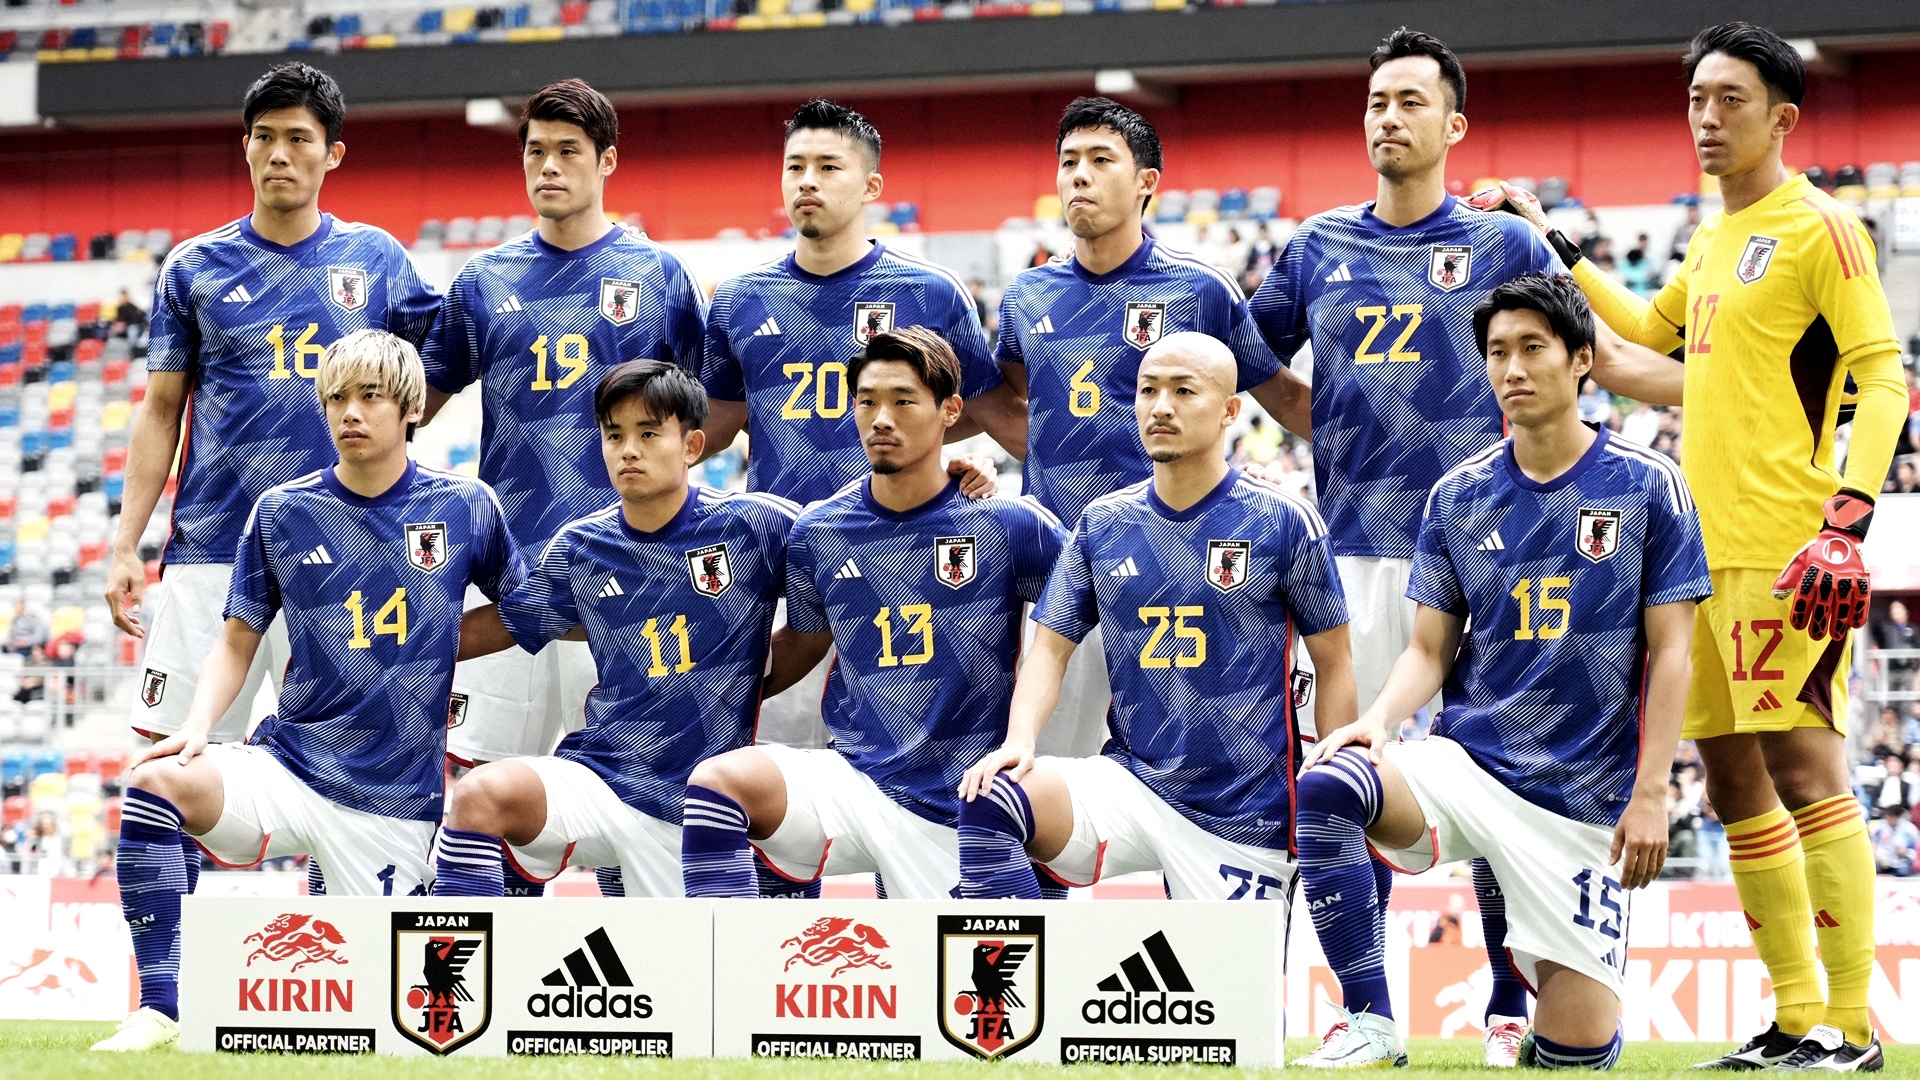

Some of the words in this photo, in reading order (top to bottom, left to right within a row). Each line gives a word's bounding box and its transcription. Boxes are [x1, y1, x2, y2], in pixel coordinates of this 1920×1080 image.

[610, 308, 627, 318] JFA
[1688, 294, 1720, 354] 12
[265, 322, 327, 380] 16
[1133, 333, 1151, 342] JFA
[1354, 303, 1424, 365] 22
[529, 333, 590, 391] 19
[781, 361, 849, 420] 20
[1068, 359, 1101, 418] 6
[419, 556, 437, 565] JFA
[696, 546, 718, 556] JAPAN
[1587, 544, 1606, 553] JFA
[705, 579, 724, 590] JFA
[946, 571, 965, 580] JFA
[1217, 574, 1236, 584] JFA
[343, 587, 407, 649] 14
[1510, 576, 1571, 641] 15
[640, 614, 697, 677] 11
[872, 603, 935, 667] 13
[1138, 605, 1207, 669] 25
[1730, 619, 1785, 681] 12
[376, 864, 428, 896] 1
[1572, 868, 1622, 940] 15
[415, 916, 469, 927] JAPAN
[962, 919, 1020, 931] JAPAN
[1671, 912, 1752, 947] KIR
[238, 978, 353, 1012] KIRIN
[527, 985, 653, 1019] adidas
[775, 983, 897, 1019] KIRIN
[1081, 991, 1216, 1025] adidas
[1623, 958, 1920, 1043] KIRN
[417, 1011, 464, 1033] JFA
[965, 1018, 1015, 1040] JFA
[221, 1033, 293, 1050] OFFICIAL
[296, 1035, 370, 1051] PARTNER
[511, 1037, 586, 1054] OFFICIAL
[588, 1038, 669, 1055] SUPPLIER
[757, 1041, 835, 1057] OFFICIAL
[837, 1042, 915, 1059] PARTNER
[1065, 1044, 1145, 1061] OFFICIAL
[1147, 1045, 1232, 1063] SUPPLIER
